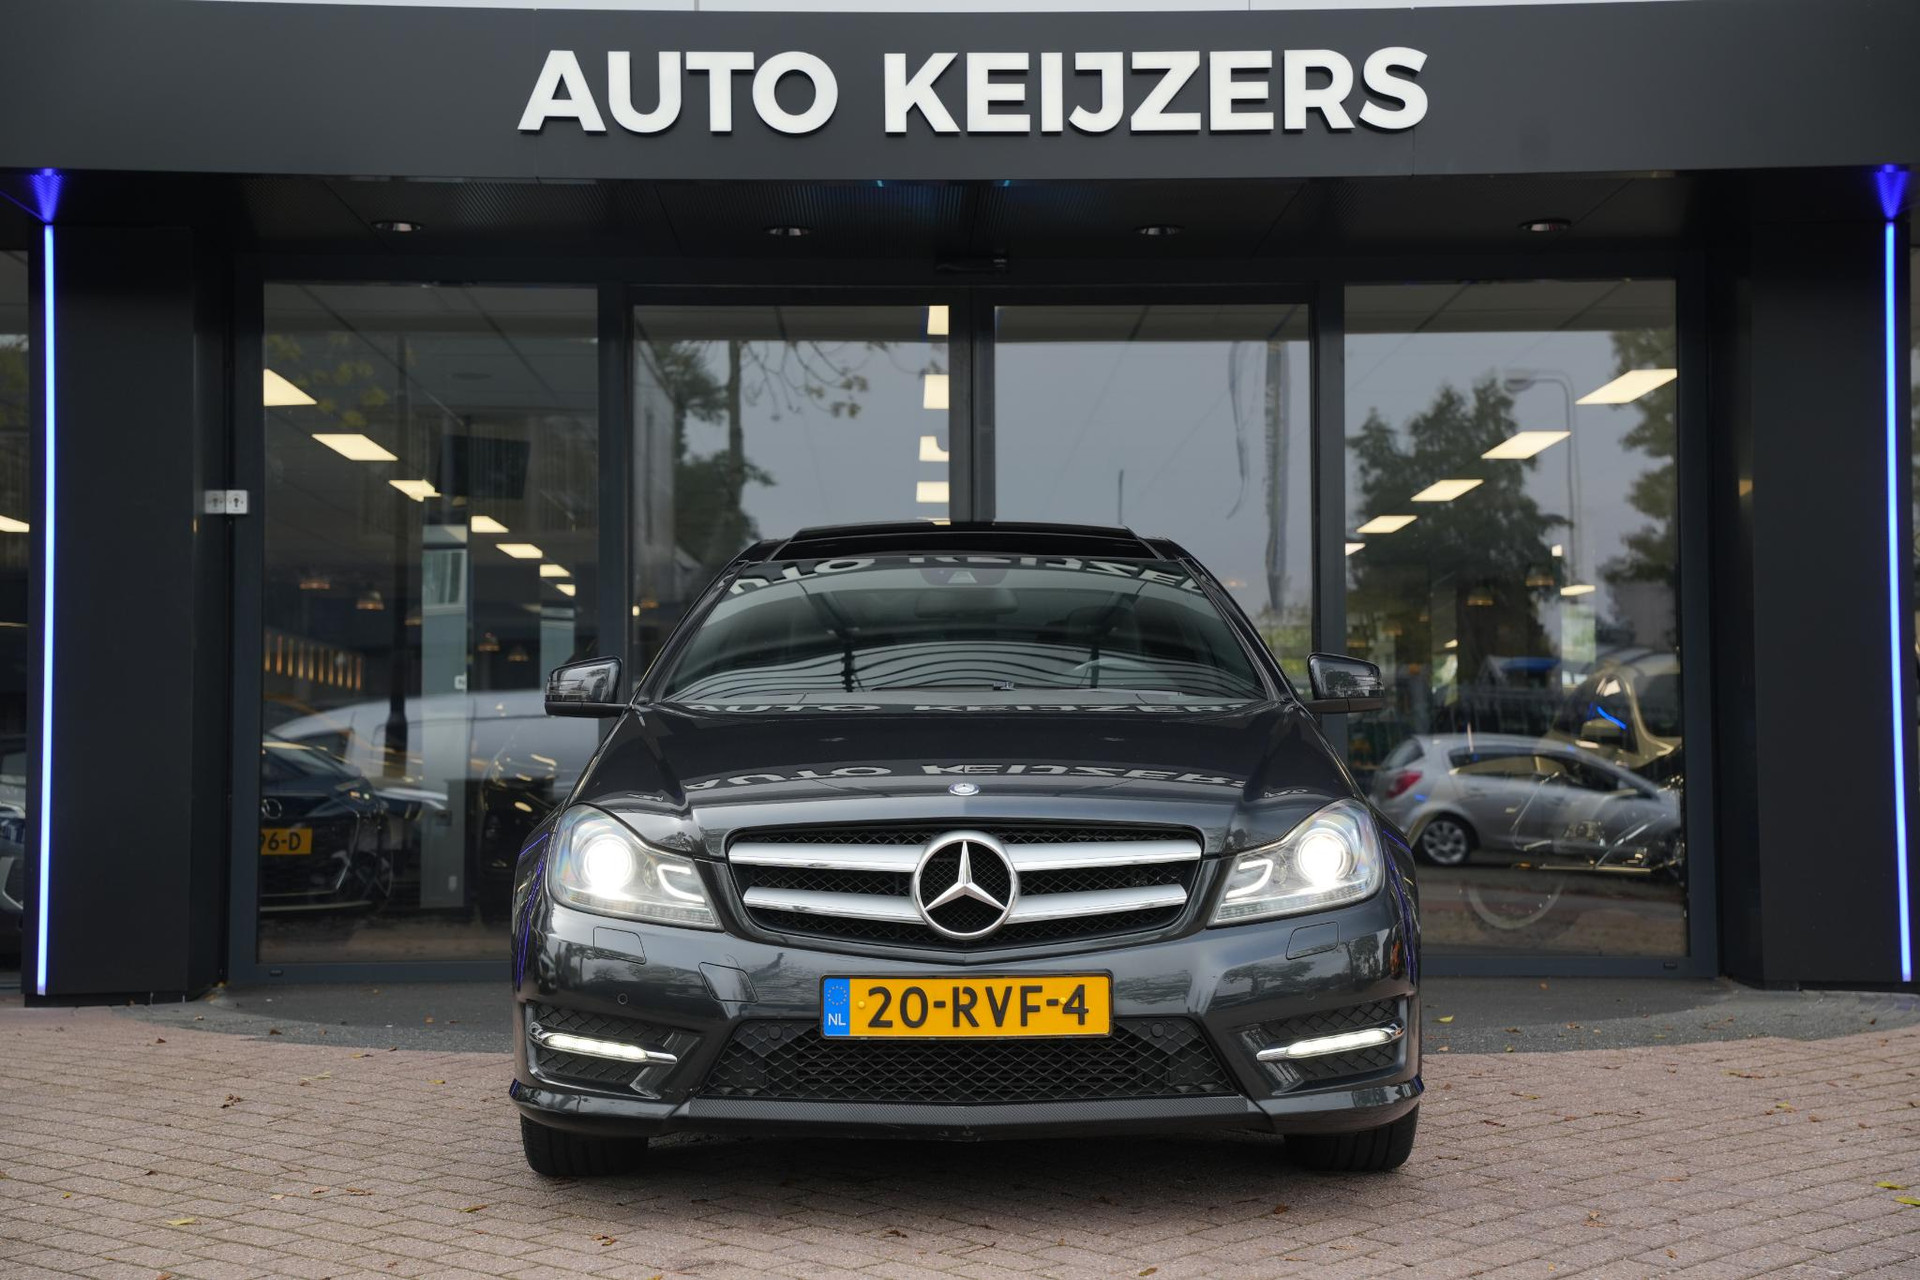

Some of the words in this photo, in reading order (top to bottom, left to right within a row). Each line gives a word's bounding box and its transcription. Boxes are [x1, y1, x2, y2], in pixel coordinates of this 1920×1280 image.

[517, 49, 839, 134] AUTO
[884, 46, 1429, 133] KEIJZERS
[828, 1012, 846, 1027] NL
[867, 984, 1089, 1029] 20-RVF-4
